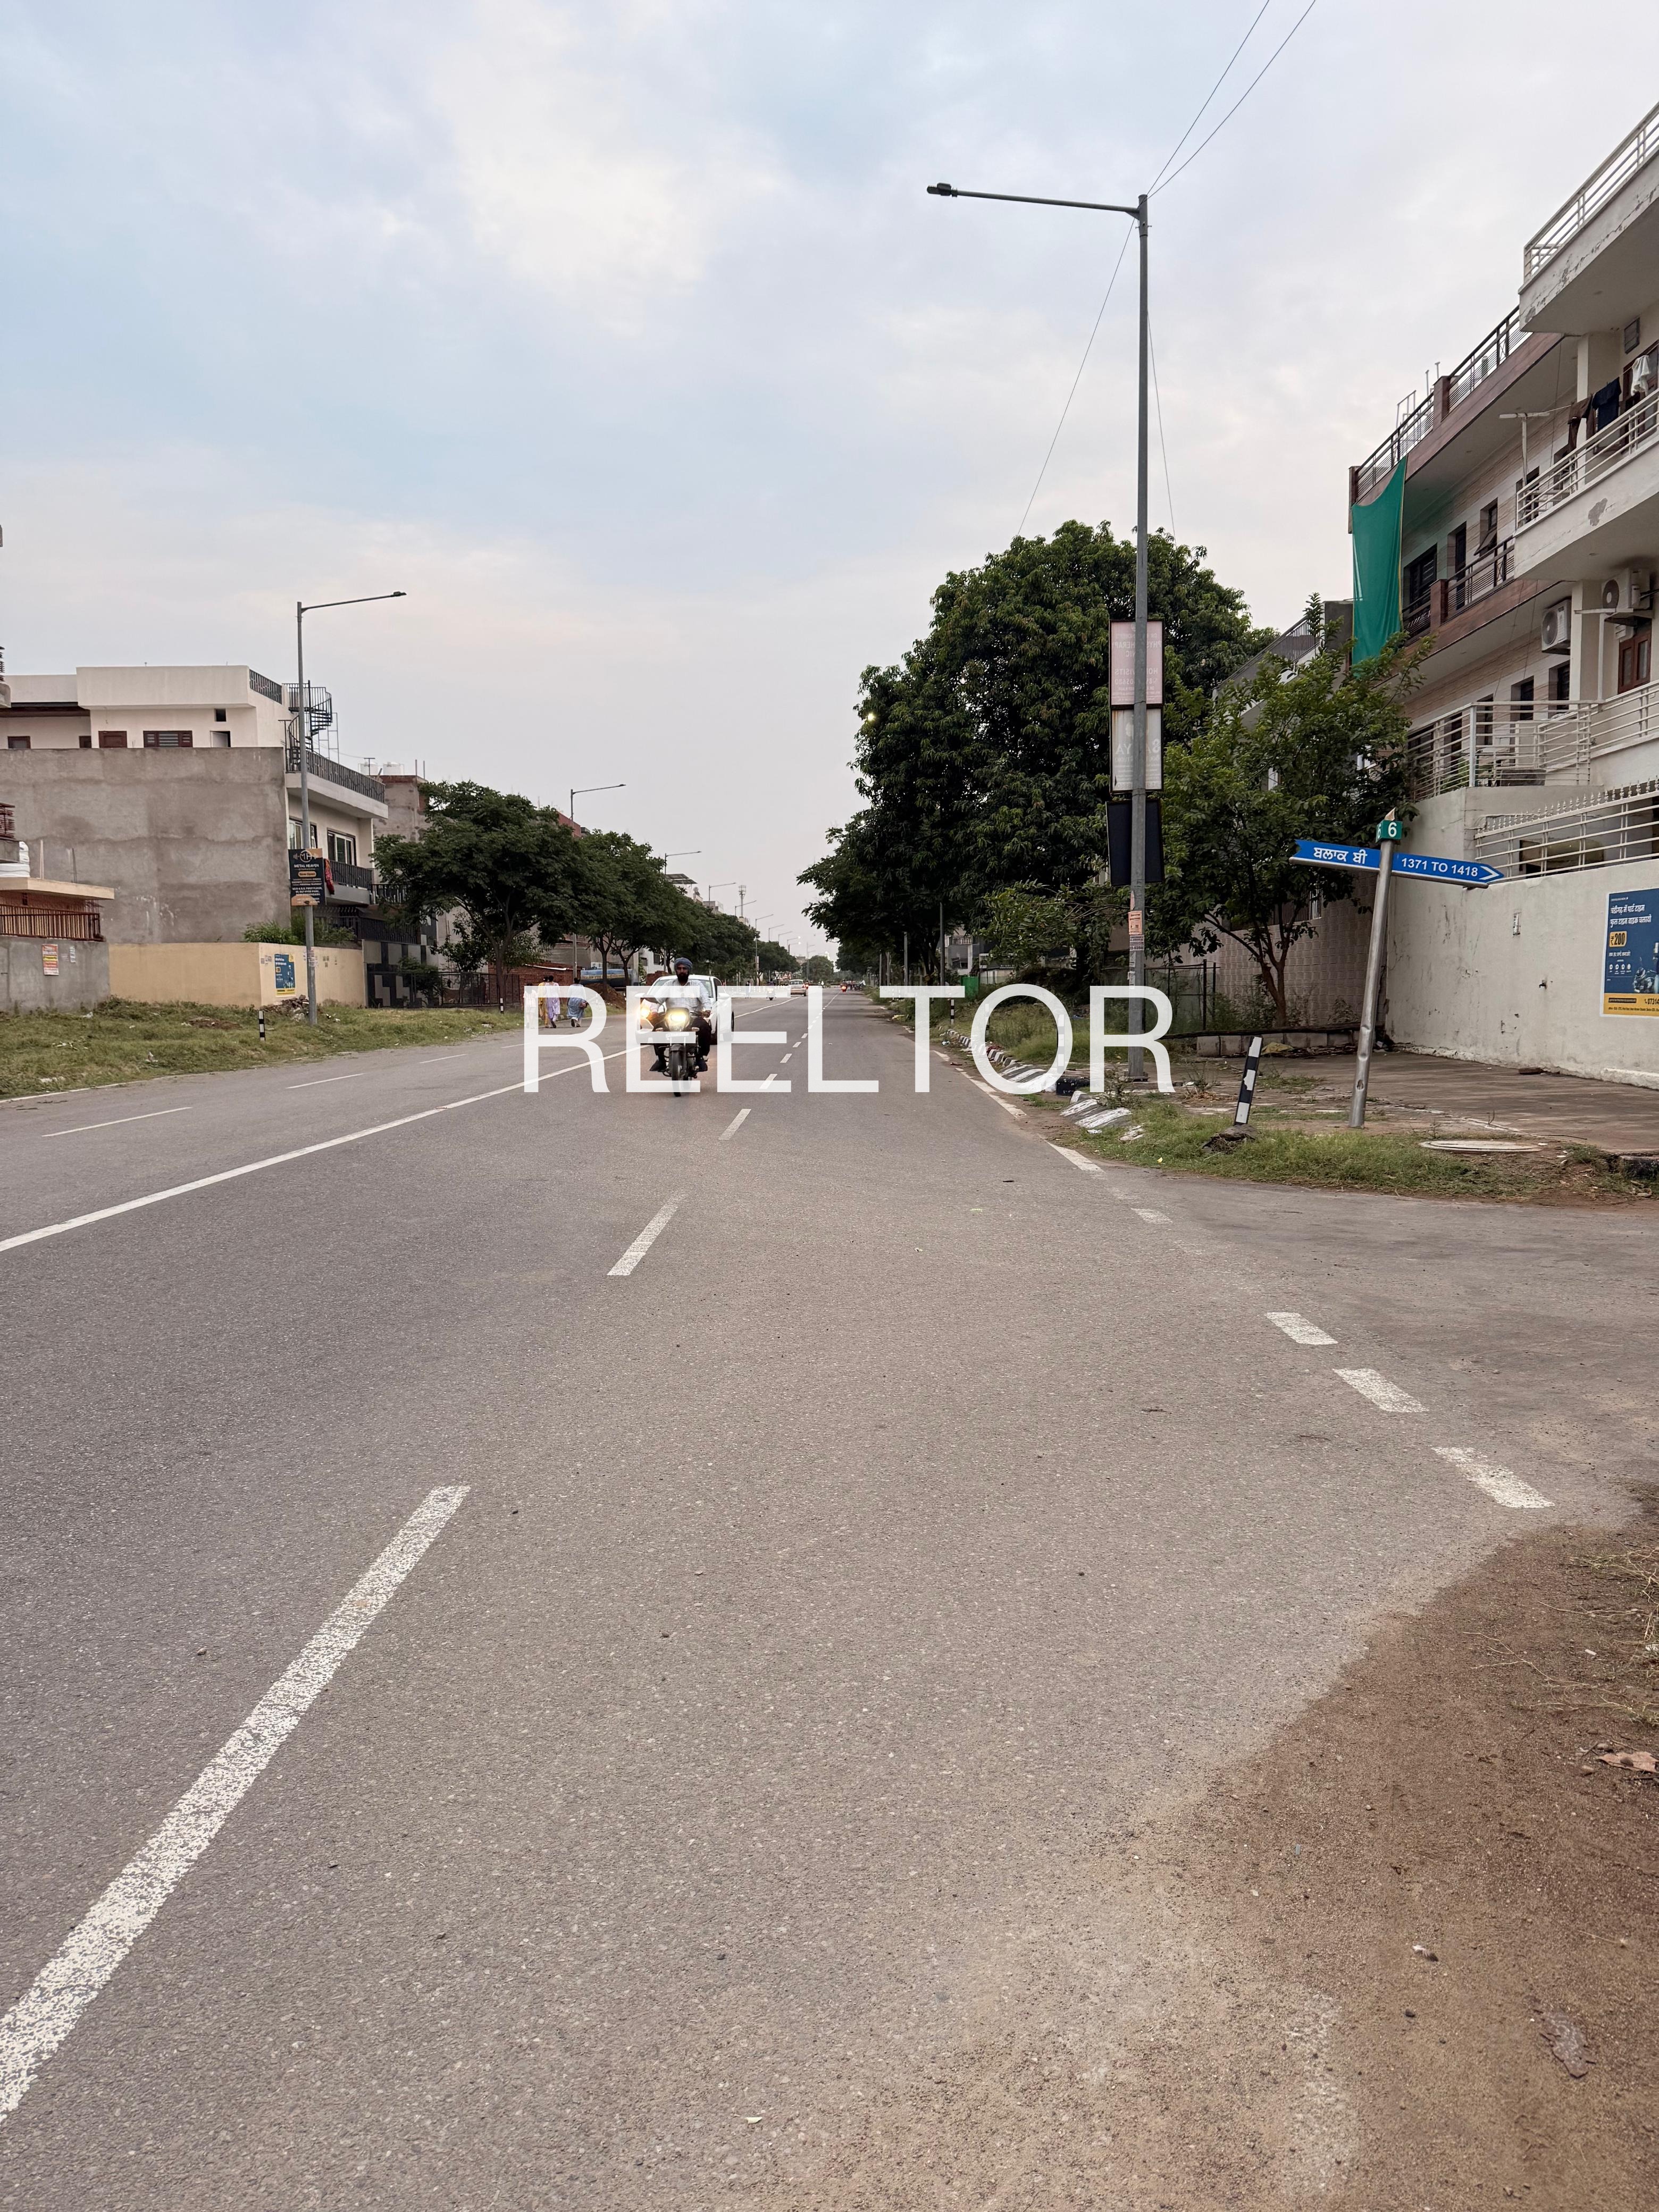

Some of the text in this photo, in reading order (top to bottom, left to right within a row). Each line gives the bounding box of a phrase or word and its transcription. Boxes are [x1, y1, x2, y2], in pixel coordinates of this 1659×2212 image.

[1377, 824, 1381, 839] 6
[1388, 822, 1397, 837] 6
[1313, 847, 1368, 864] ਬਲਾਕ ਬੀ
[1402, 858, 1478, 876] 1371 TO 1418
